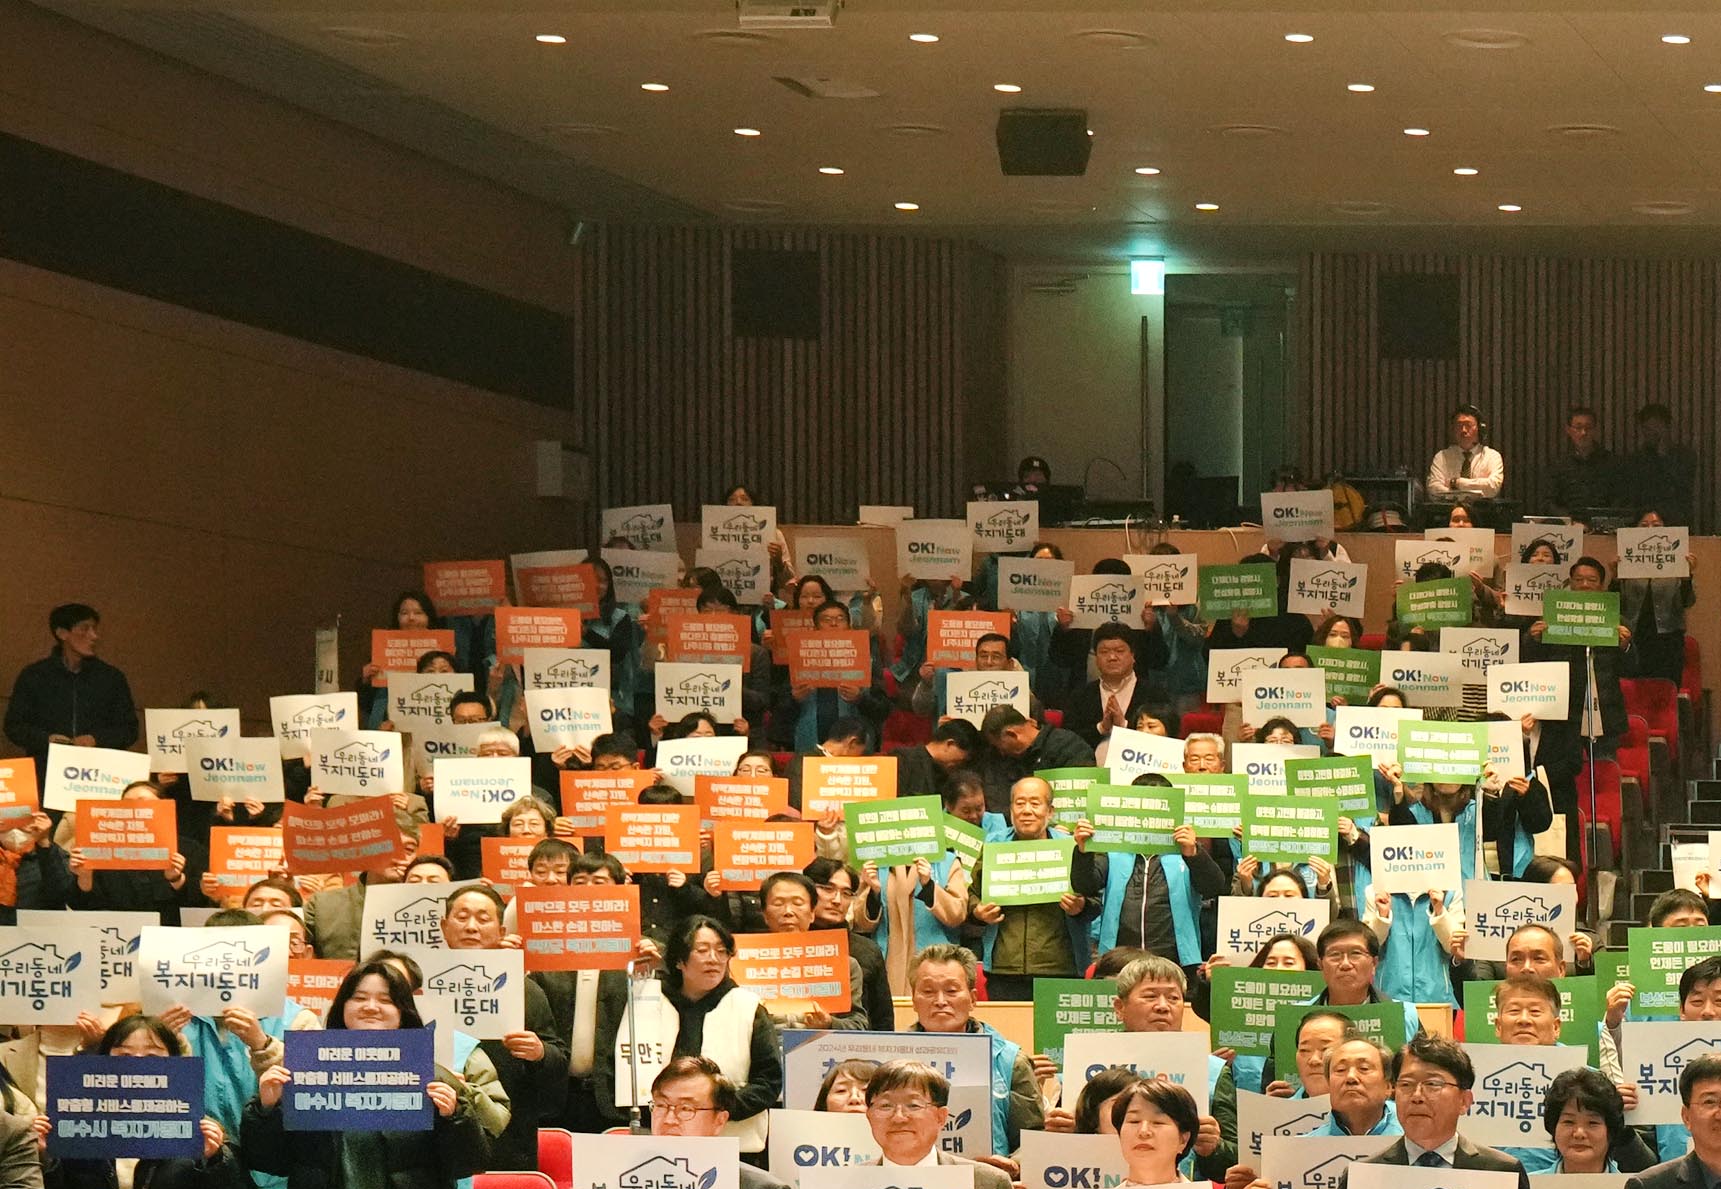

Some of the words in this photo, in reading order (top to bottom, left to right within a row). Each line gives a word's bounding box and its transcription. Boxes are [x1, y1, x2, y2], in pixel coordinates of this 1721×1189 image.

[1255, 686, 1285, 699] OK!
[1501, 681, 1528, 693] OK!
[664, 685, 724, 711] 복지기동대
[1501, 693, 1556, 705] Jeonnam
[1256, 701, 1313, 711] Jeonnam
[540, 709, 570, 722] OK!
[572, 710, 600, 721] Now
[543, 721, 600, 734] Jeonnam
[201, 757, 233, 771] OK!
[235, 761, 265, 772] Now
[318, 753, 385, 786] 복지기동대
[204, 772, 266, 783] Jeonnam
[1382, 846, 1413, 862] OK!
[1415, 849, 1444, 860] Now
[1384, 860, 1445, 873] Jeonnam
[188, 953, 253, 968] 우리동네
[153, 958, 258, 1000] 복지기동대
[794, 1144, 850, 1168] OK!
